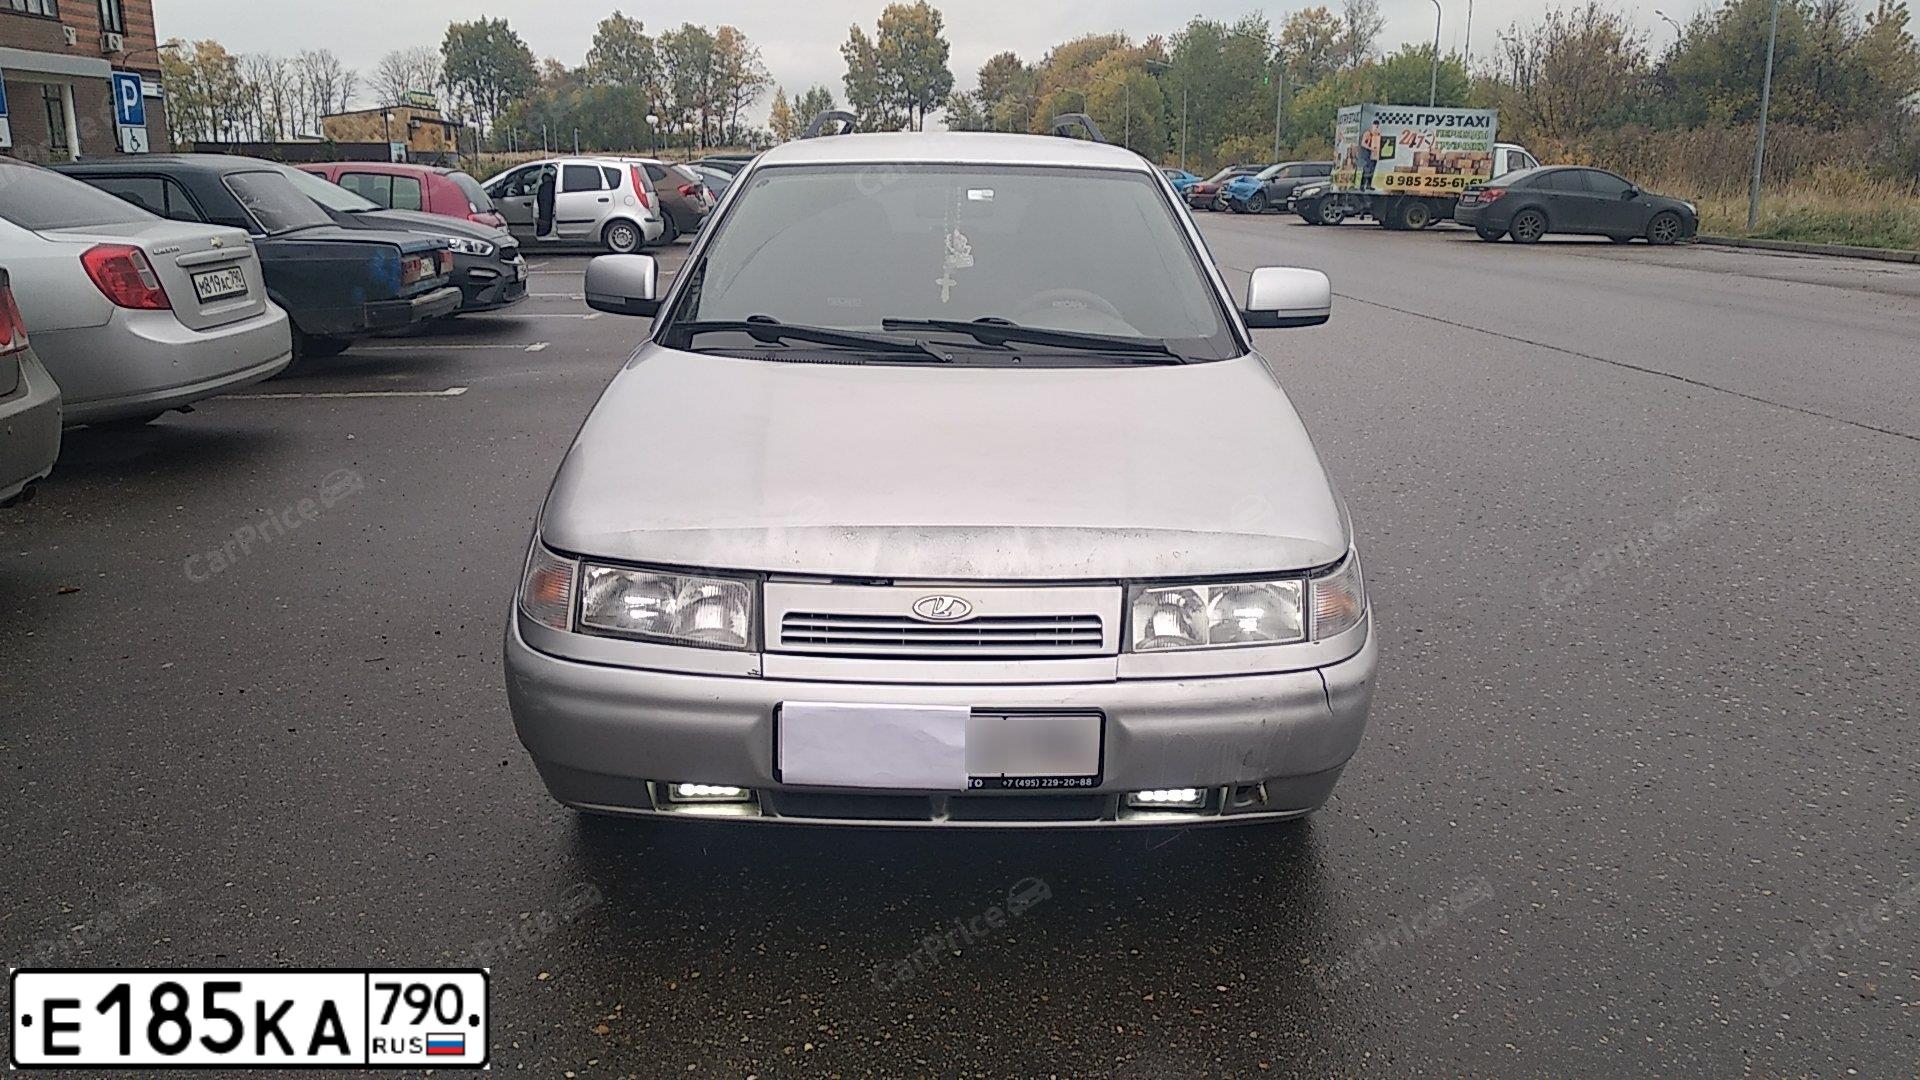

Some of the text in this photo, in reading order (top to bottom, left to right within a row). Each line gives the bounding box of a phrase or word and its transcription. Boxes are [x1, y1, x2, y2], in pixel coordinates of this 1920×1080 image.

[121, 79, 138, 121] P
[1386, 176, 1394, 186] 8
[1397, 176, 1421, 186] 985
[1002, 777, 1092, 788] +7 (495) 229-20-88
